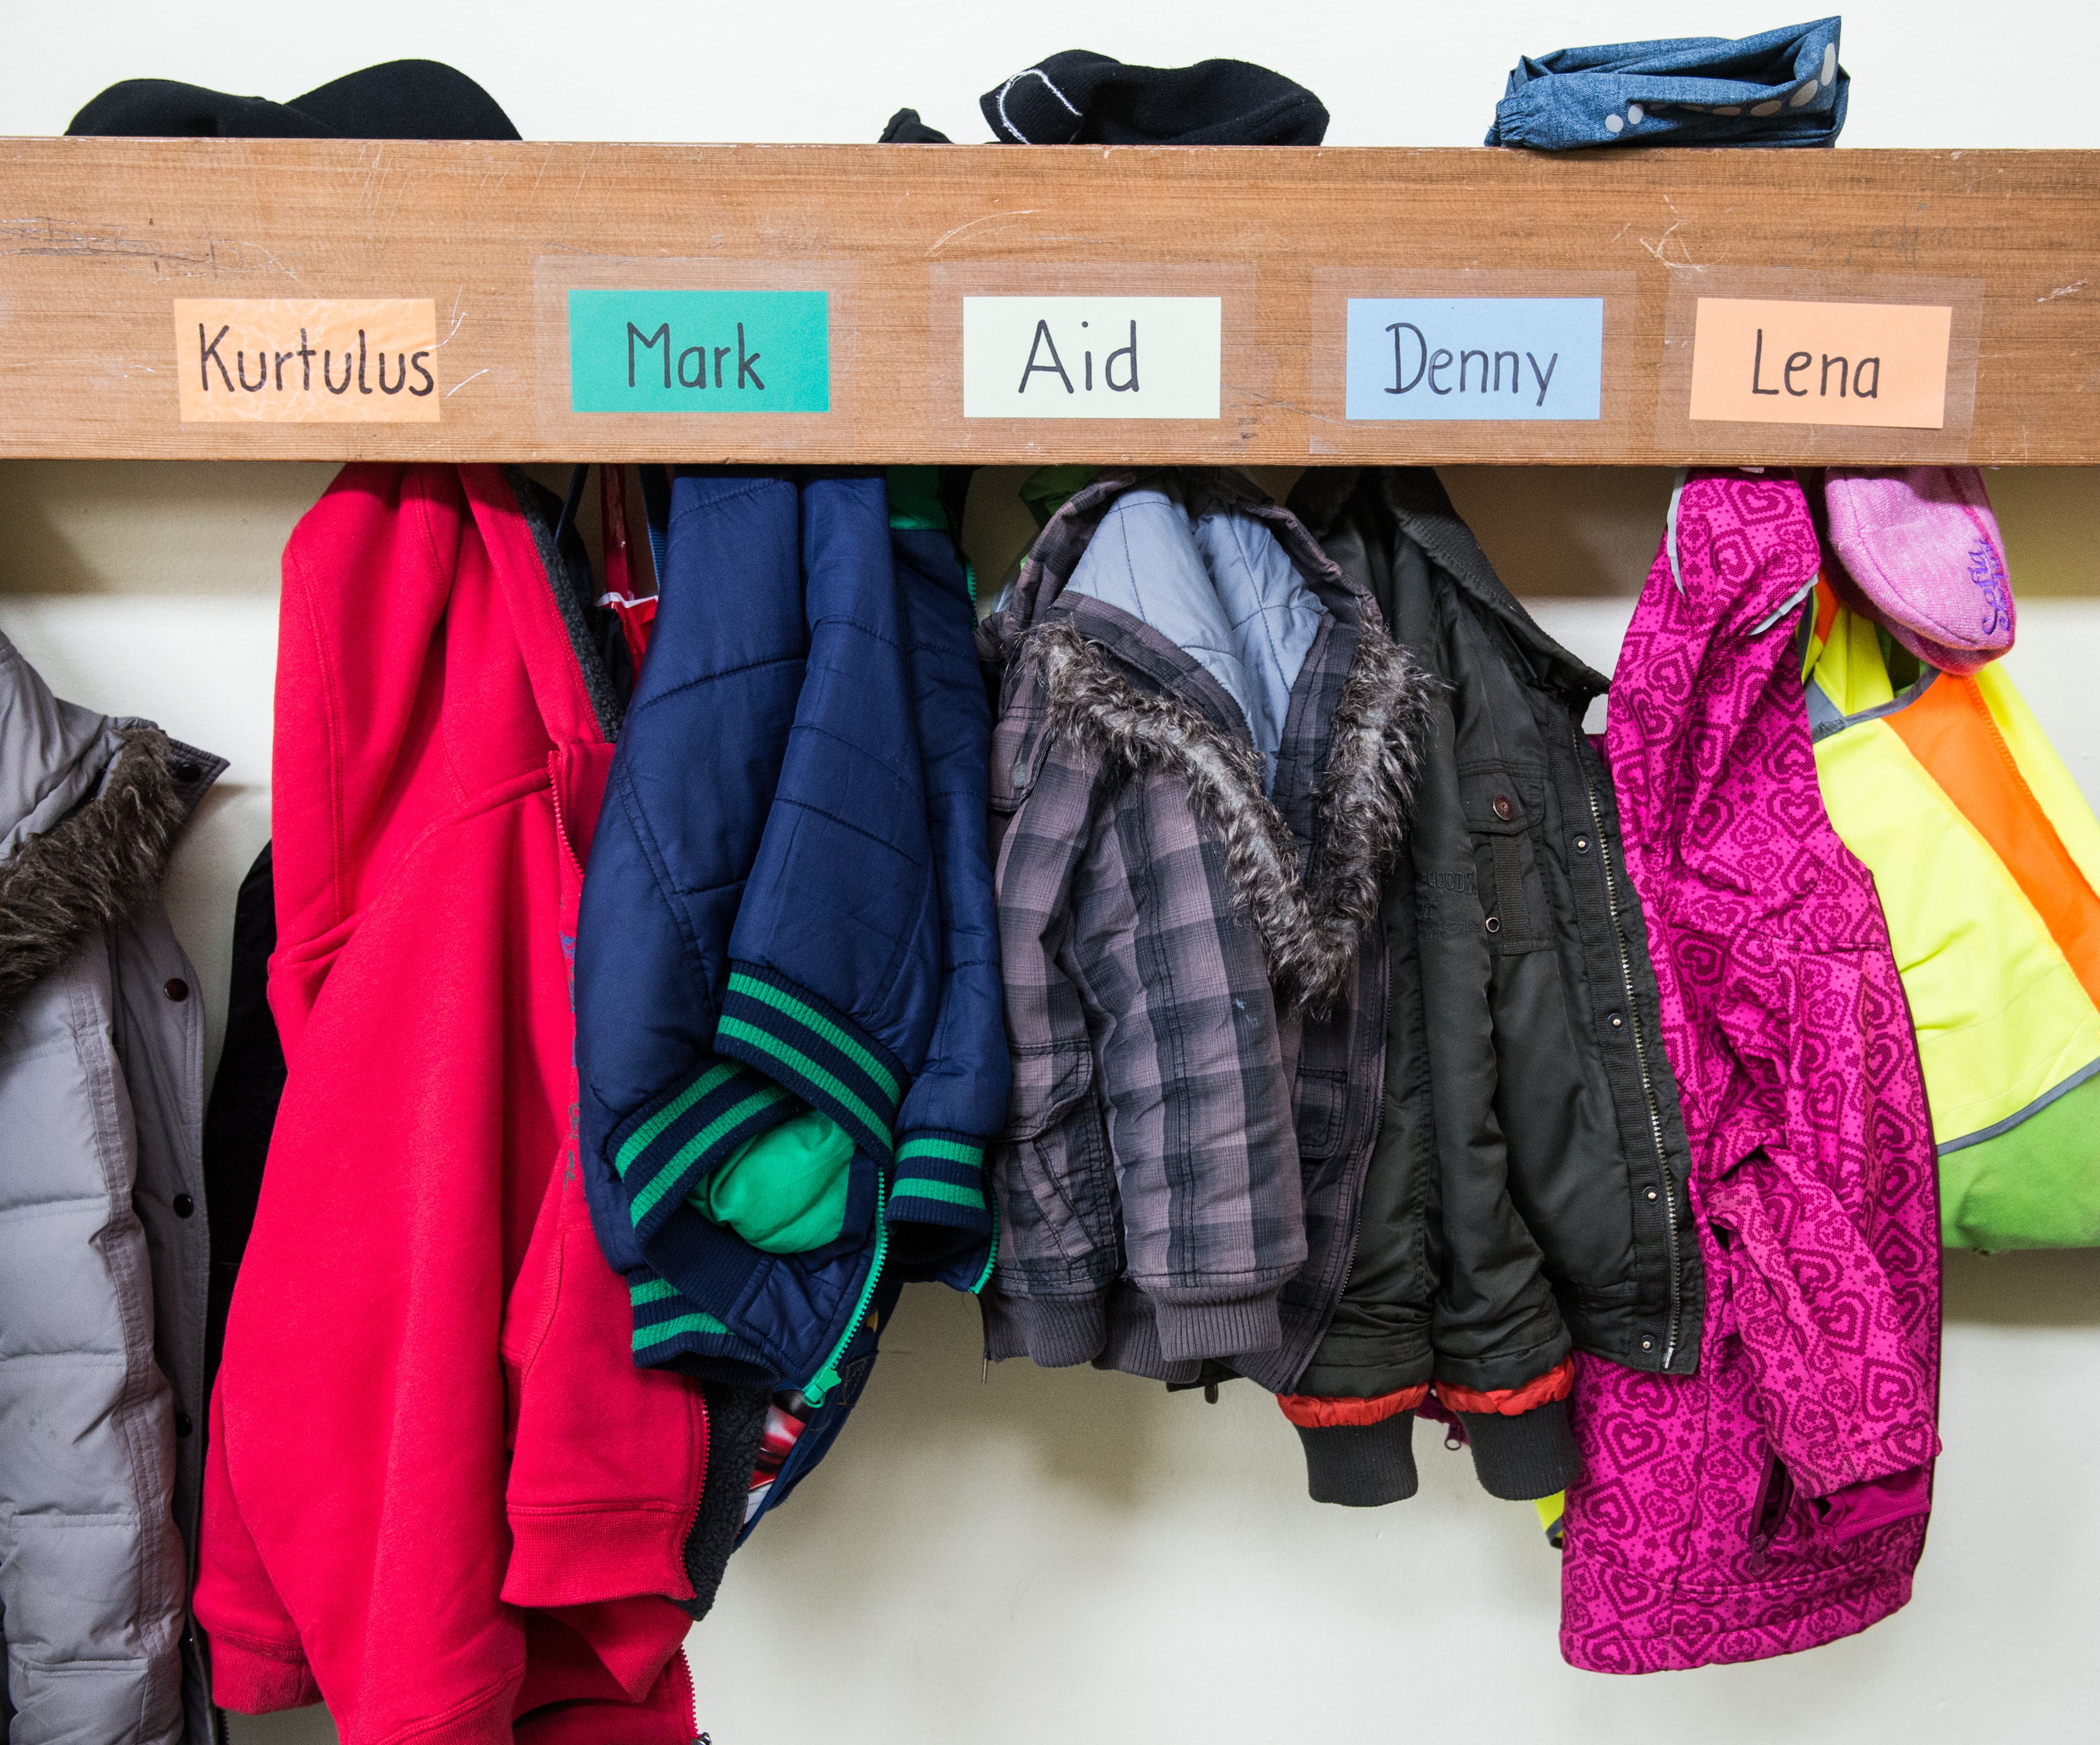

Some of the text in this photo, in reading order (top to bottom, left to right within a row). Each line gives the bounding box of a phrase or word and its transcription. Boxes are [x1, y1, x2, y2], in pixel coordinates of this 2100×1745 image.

[199, 322, 434, 396] Kurtulus
[627, 322, 765, 392] Mark
[1018, 318, 1140, 394] Aid
[1383, 322, 1558, 407] Denny
[1752, 328, 1880, 399] Lena
[1968, 551, 2010, 635] Sofia
